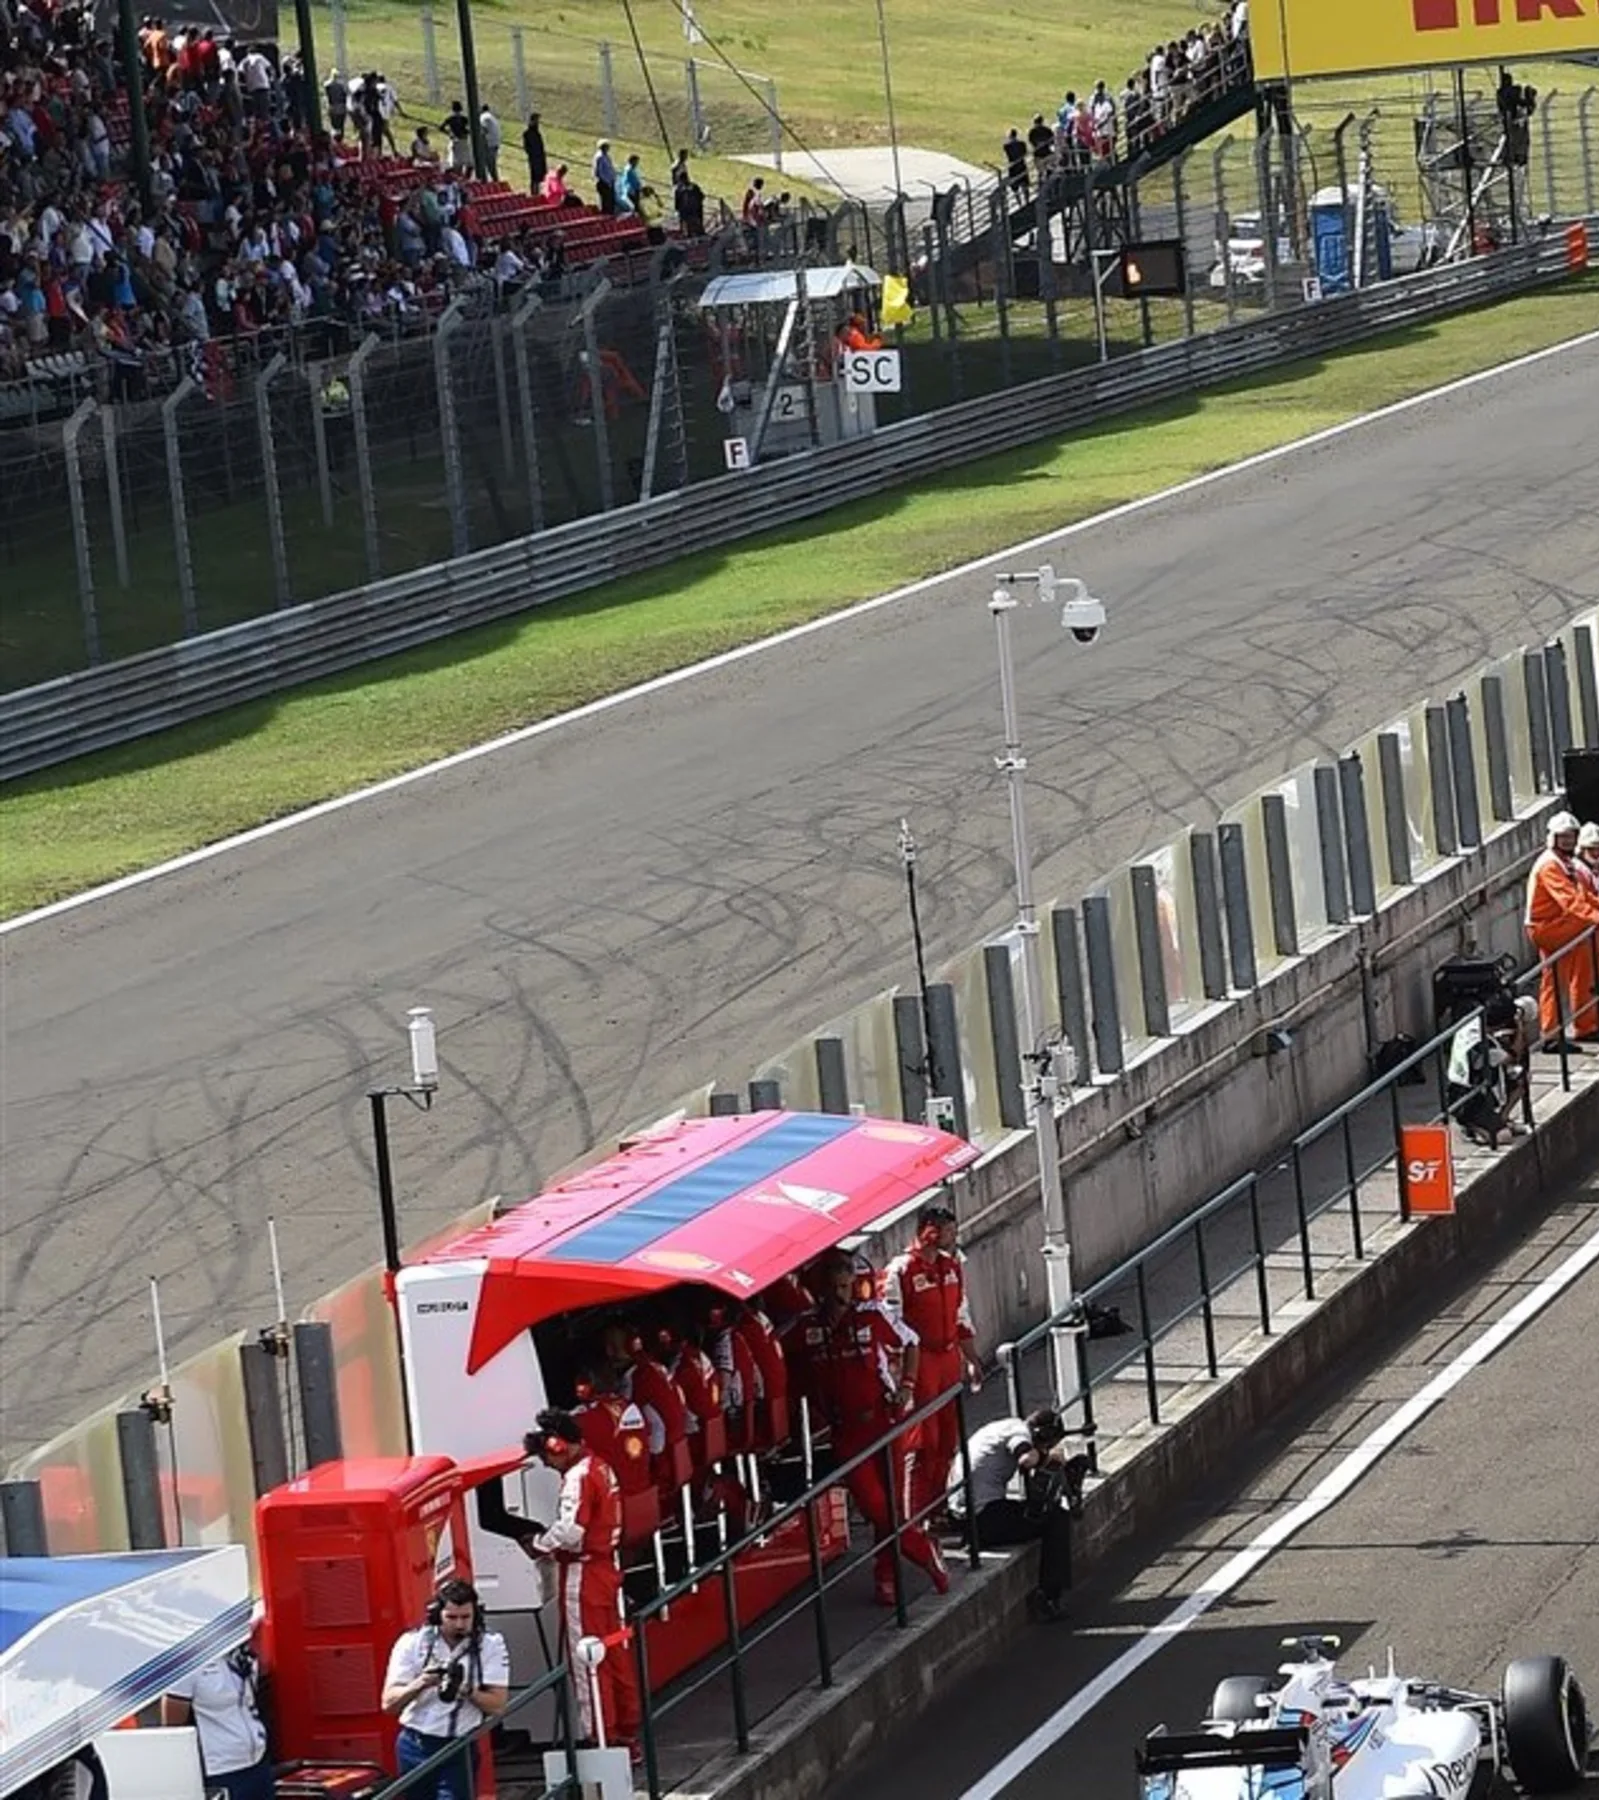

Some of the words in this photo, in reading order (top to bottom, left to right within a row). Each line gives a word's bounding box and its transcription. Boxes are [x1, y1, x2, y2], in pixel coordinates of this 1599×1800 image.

[851, 356, 893, 385] SC
[780, 394, 794, 416] 2
[729, 442, 743, 465] F
